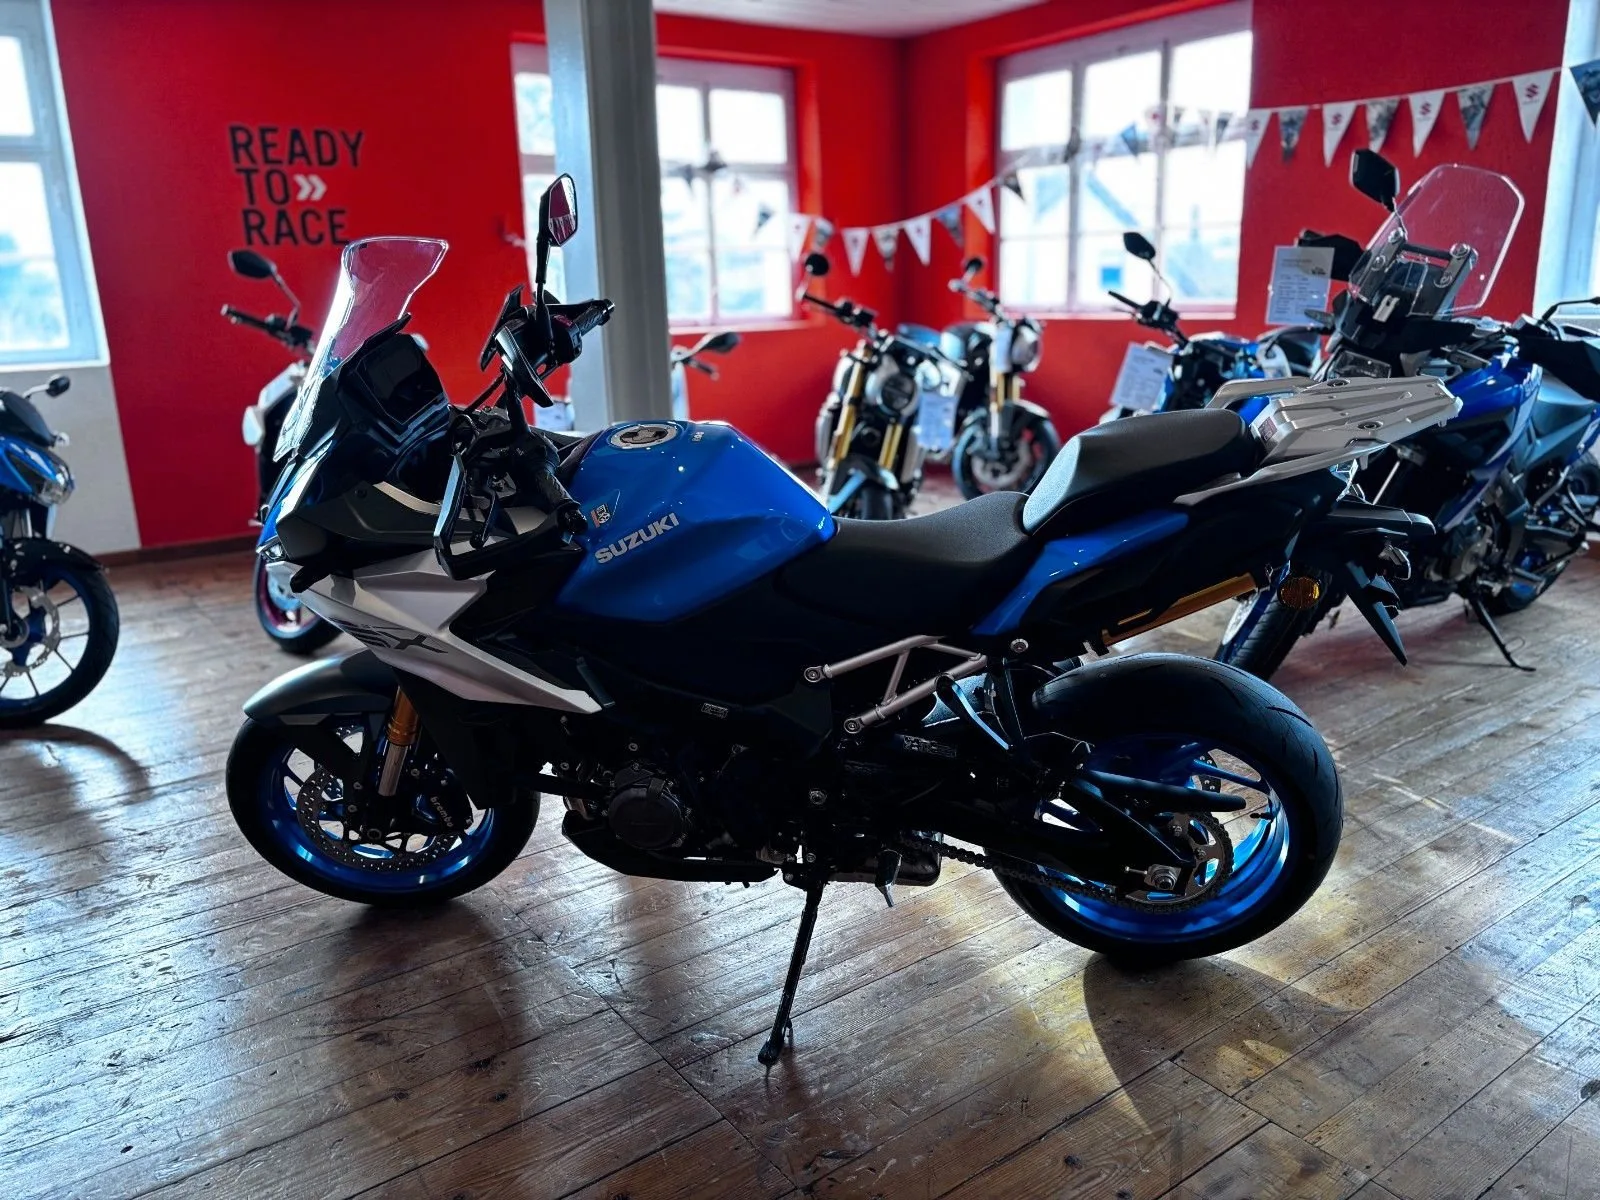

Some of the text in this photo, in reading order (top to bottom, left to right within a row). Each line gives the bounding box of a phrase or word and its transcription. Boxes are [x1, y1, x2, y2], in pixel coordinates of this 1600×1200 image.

[229, 126, 363, 167] READY
[235, 168, 291, 205] TO
[242, 208, 349, 245] RACE
[594, 512, 680, 564] SUZUKI
[429, 795, 455, 828] brembo
